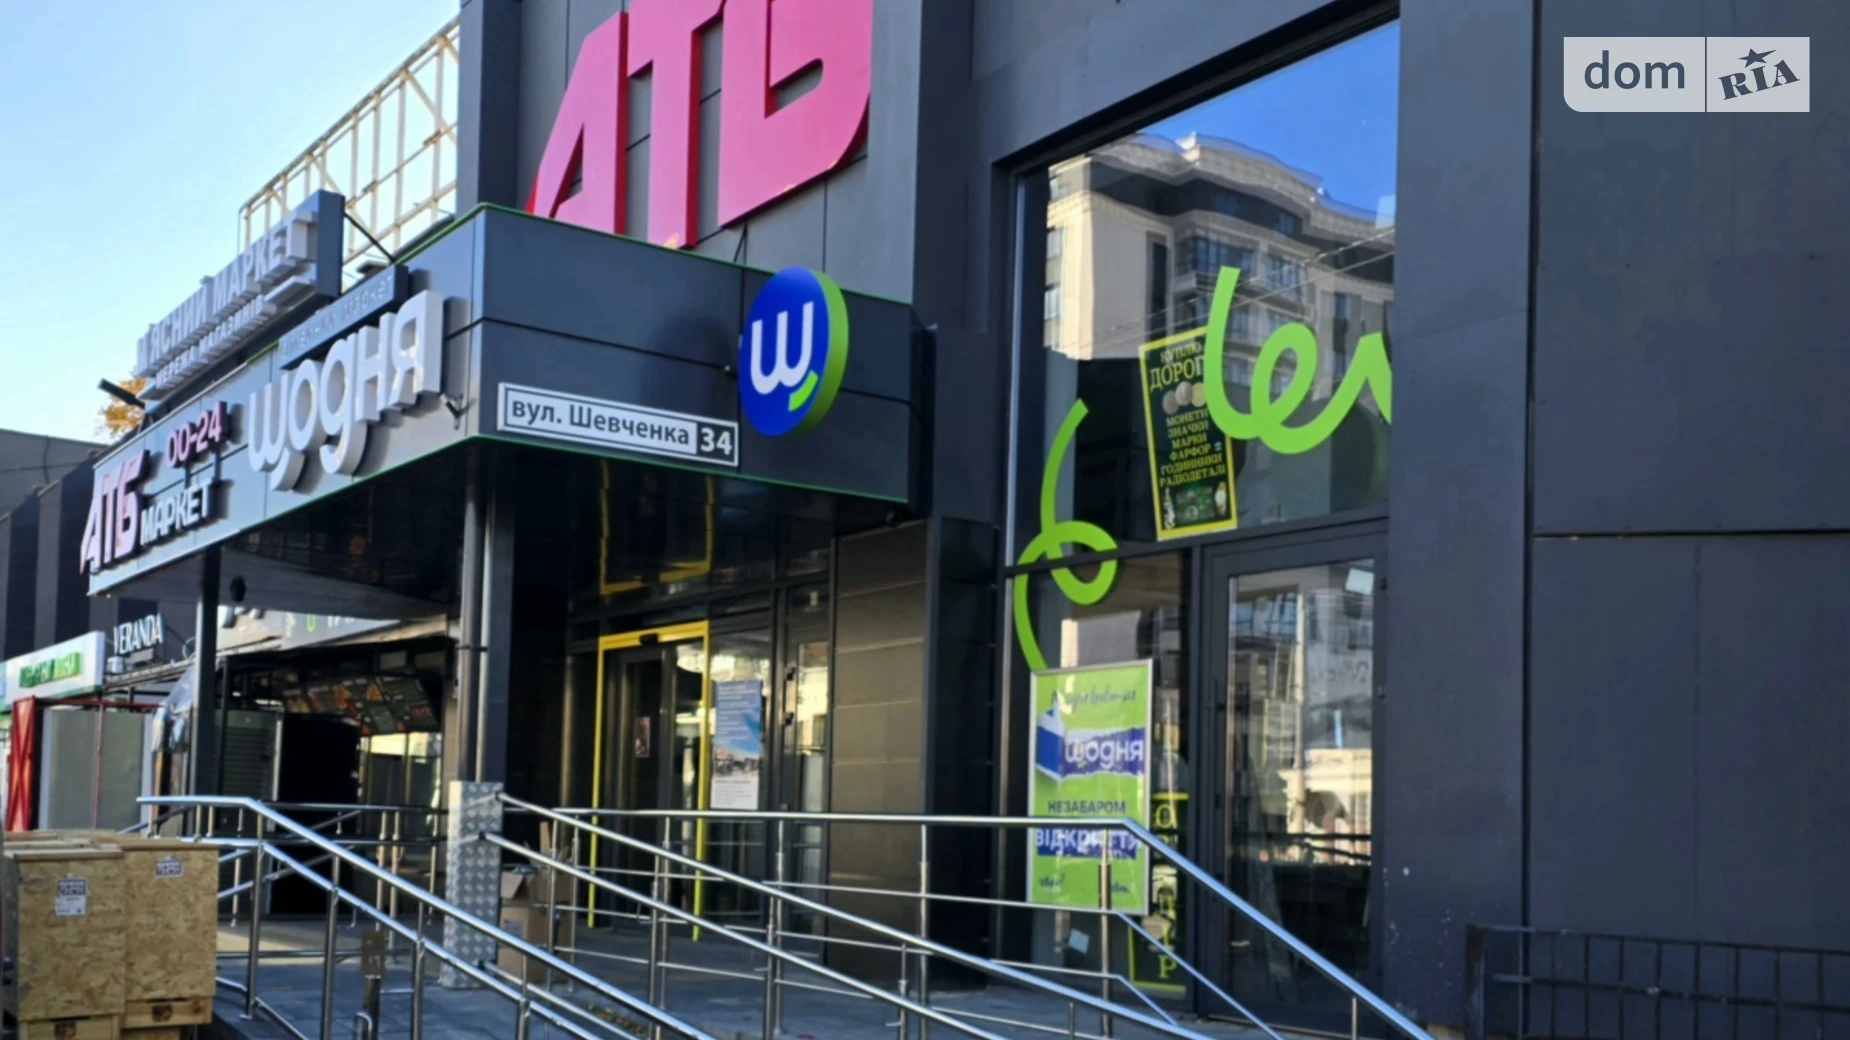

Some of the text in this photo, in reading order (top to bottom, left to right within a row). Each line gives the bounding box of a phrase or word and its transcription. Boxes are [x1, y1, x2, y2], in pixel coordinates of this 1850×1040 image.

[527, 0, 873, 248] АТБ
[511, 401, 733, 455] вул. Шевченка 34
[1166, 408, 1209, 427] МОНЕТИ
[1168, 419, 1209, 438] ЗНАЧКИ
[1169, 443, 1211, 461] ФАРФОР
[1172, 433, 1207, 450] МАРКИ
[1160, 453, 1222, 476] ГОДИННИКИ
[80, 450, 149, 574] АТБ
[140, 478, 215, 546] МАРКЕТ
[113, 612, 164, 655] VERANDA
[1047, 799, 1126, 814] НЕЗАБАРОМ
